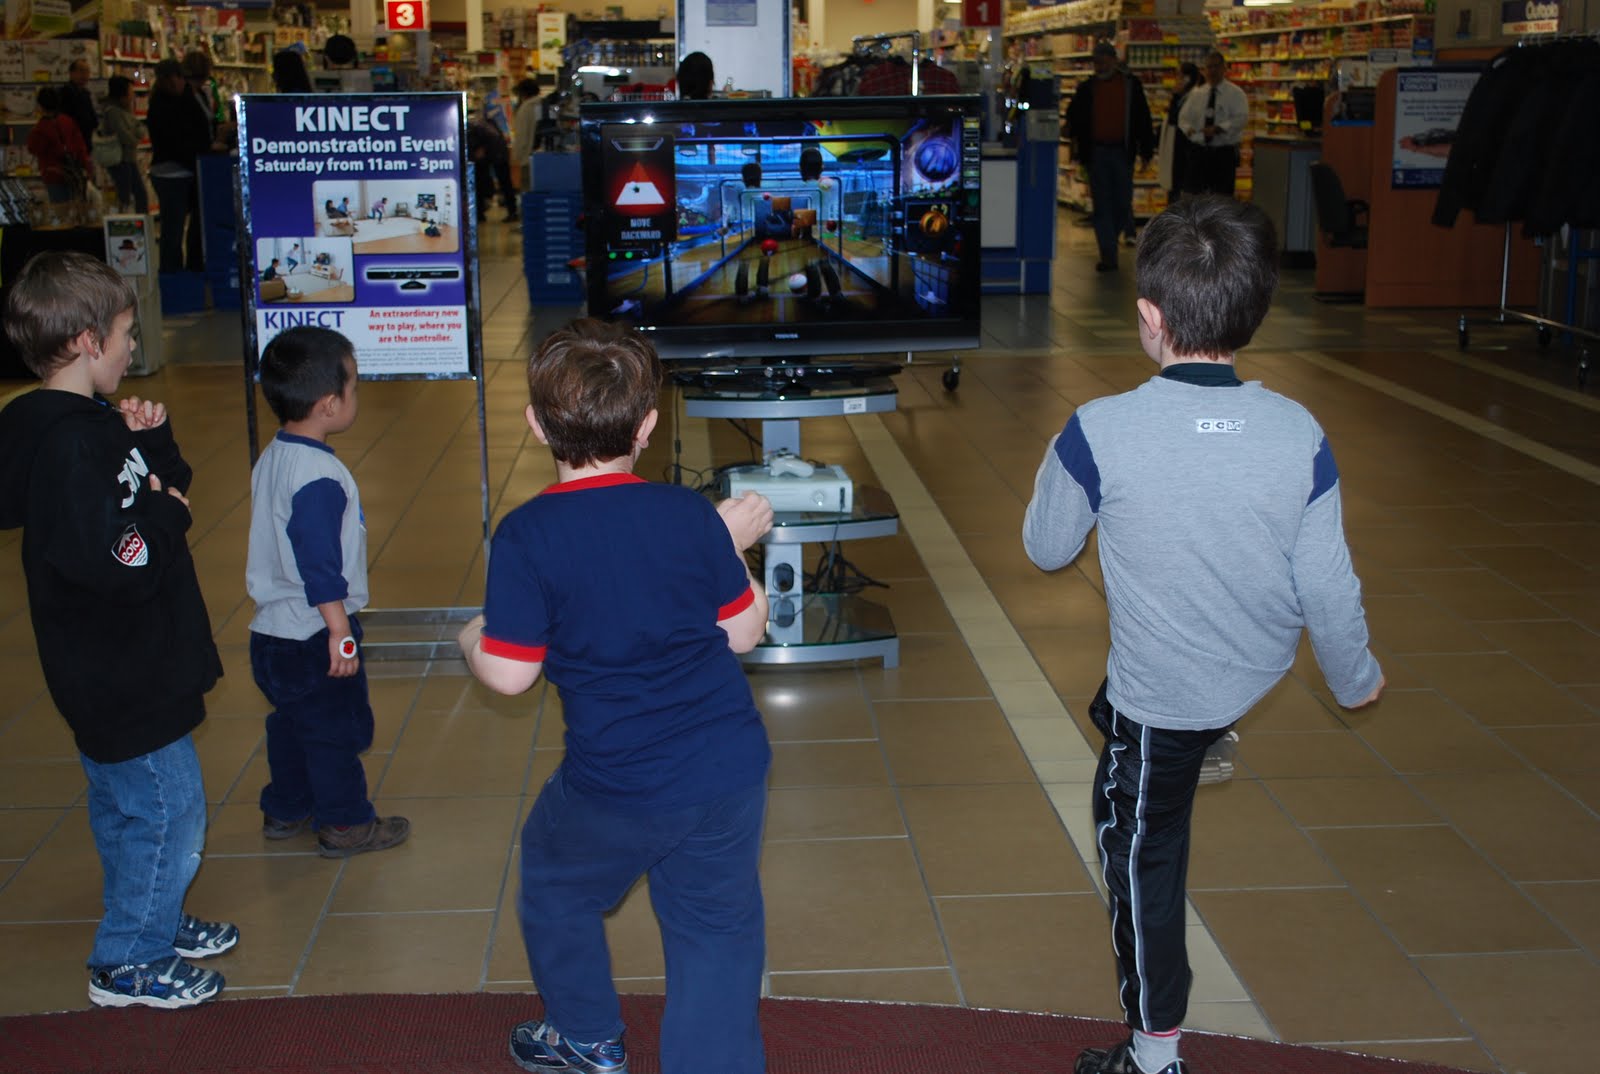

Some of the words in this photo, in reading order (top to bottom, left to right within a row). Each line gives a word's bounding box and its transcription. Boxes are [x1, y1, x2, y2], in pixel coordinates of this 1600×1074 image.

[396, 3, 415, 26] 3
[977, 3, 989, 22] 1
[295, 105, 410, 132] KINECT
[252, 136, 397, 154] Demonstration
[401, 136, 455, 152] Event
[255, 158, 324, 175] Saturday
[327, 158, 364, 171] from
[367, 158, 408, 171] 11am
[420, 157, 454, 173] 3pm
[630, 218, 652, 228] MOVE
[621, 230, 661, 240] BACKWARD
[264, 311, 345, 330] KINECT
[369, 310, 380, 318] An
[382, 309, 439, 319] extraordinary
[368, 323, 385, 332] way
[386, 322, 396, 330] to
[397, 322, 417, 332] play,
[419, 321, 445, 329] where
[447, 322, 462, 332] you
[410, 334, 453, 342] controller.
[1200, 420, 1241, 432] CCM
[121, 537, 140, 562] 2010
